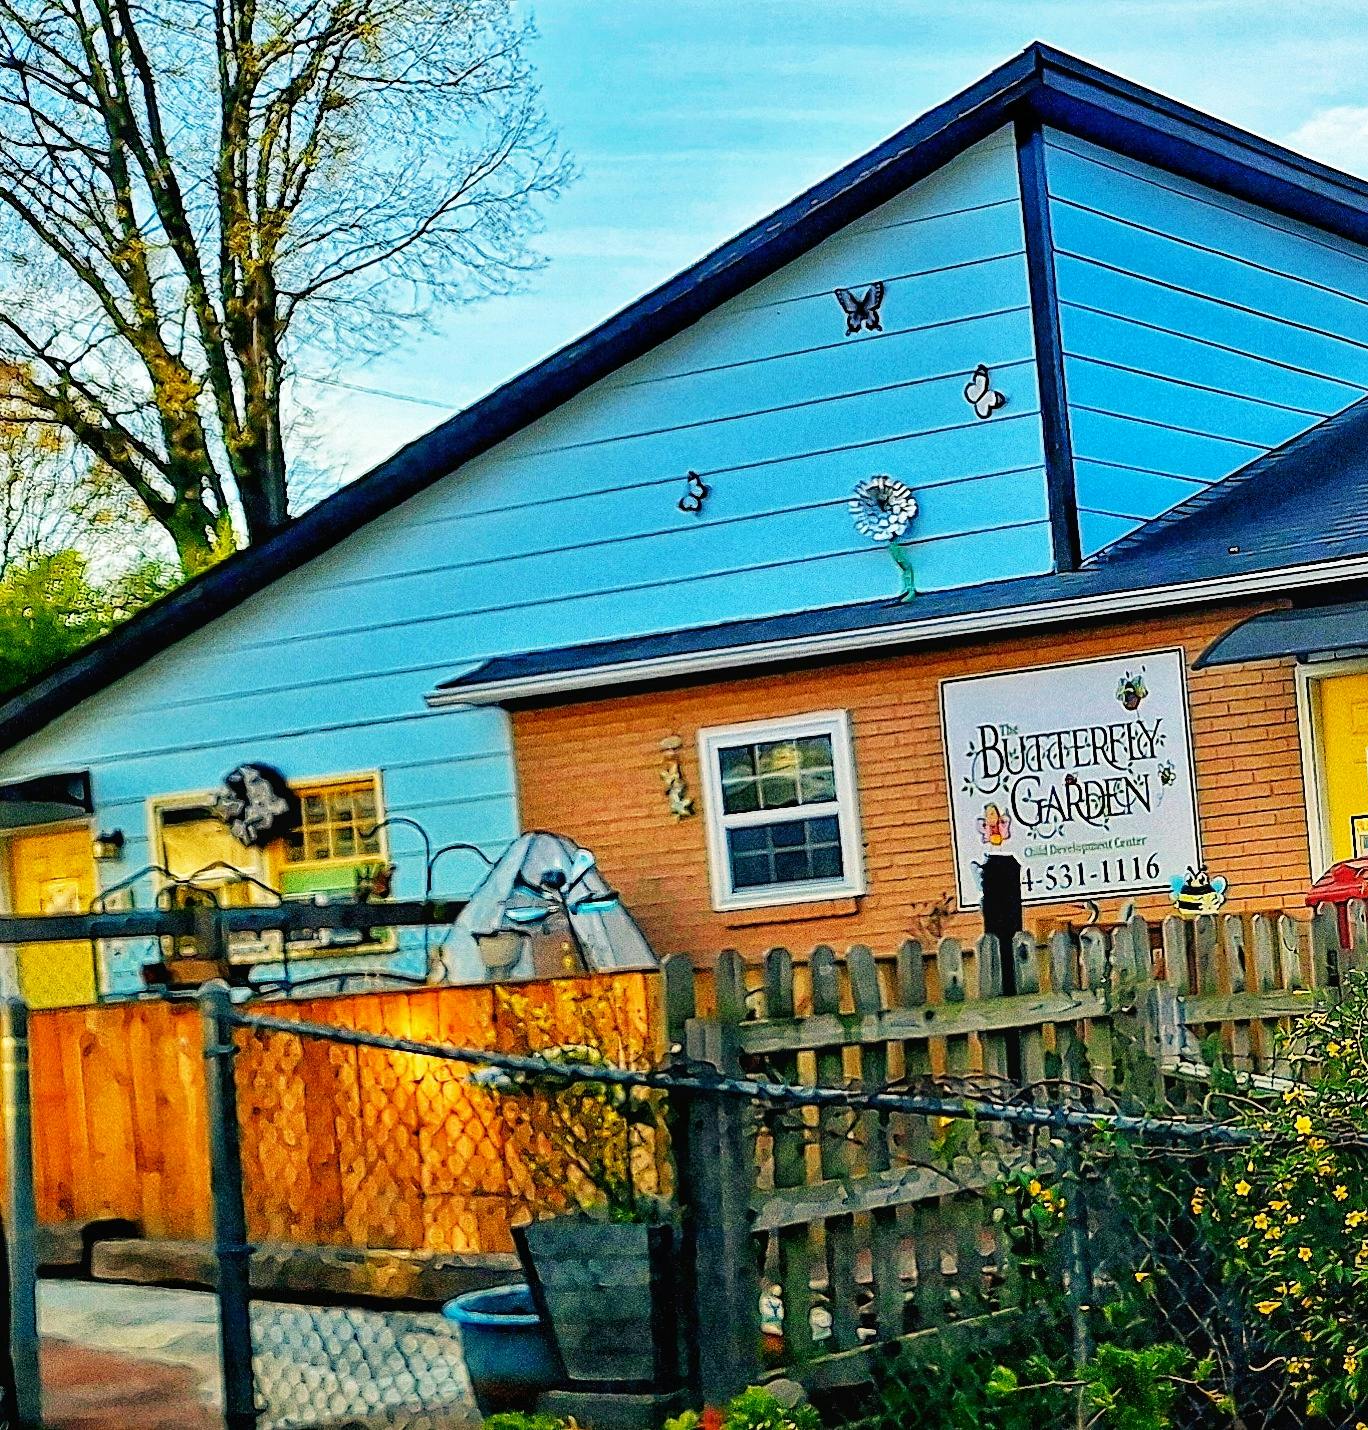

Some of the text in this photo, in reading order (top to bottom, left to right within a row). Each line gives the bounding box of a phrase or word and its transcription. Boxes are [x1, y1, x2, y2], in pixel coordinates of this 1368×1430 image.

[976, 718, 1163, 780] BUTTERFLY
[1010, 773, 1151, 828] GARDEN
[1049, 839, 1113, 855] Development
[1114, 836, 1149, 849] Center
